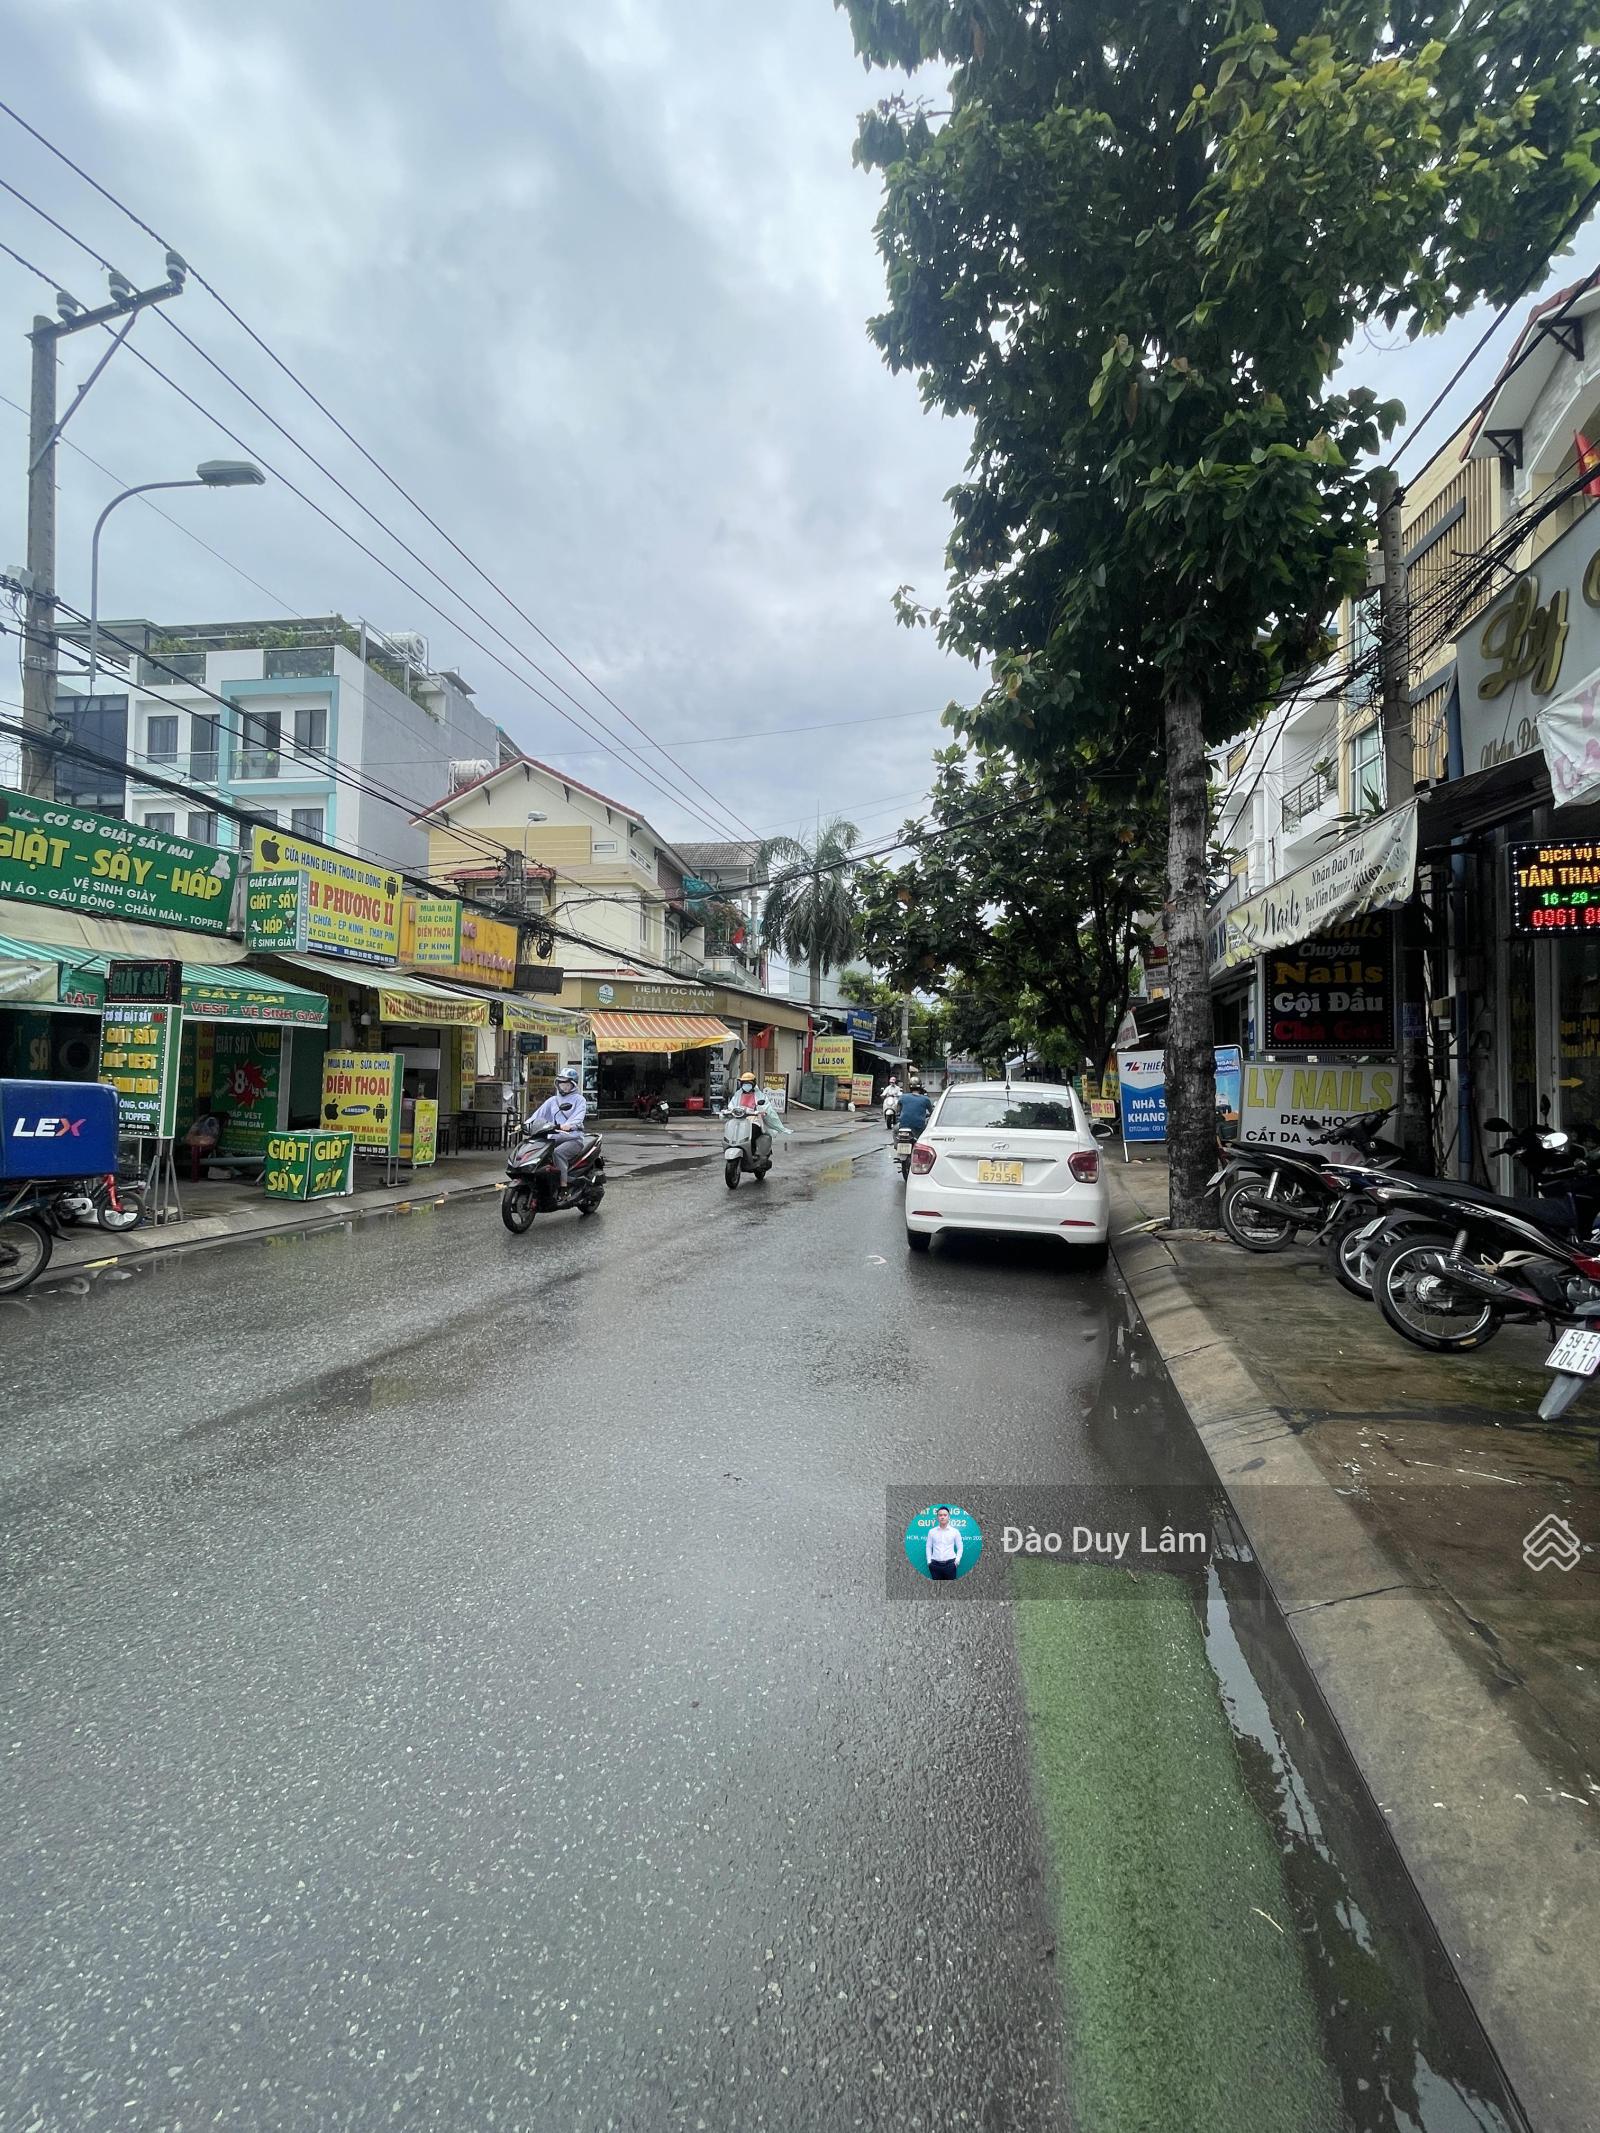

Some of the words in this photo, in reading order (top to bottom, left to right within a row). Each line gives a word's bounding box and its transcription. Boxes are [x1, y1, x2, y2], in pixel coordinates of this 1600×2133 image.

[43, 812, 71, 827] CƠ
[71, 815, 97, 834] SỞ
[99, 826, 136, 851] GIẶT
[136, 830, 167, 853] SẤY
[167, 844, 194, 860] MAI
[1539, 849, 1572, 863] DỊCH
[91, 846, 154, 885] SẤY
[170, 865, 222, 900] HẤP
[1518, 864, 1554, 887] TÂN
[73, 878, 91, 892] VỆ
[92, 882, 123, 896] SINH
[127, 887, 157, 902] GIÀY
[15, 881, 37, 896] ÁO
[48, 886, 77, 902] GẤU
[80, 892, 116, 911] BÔNG
[124, 903, 156, 918] CHĂN
[159, 908, 183, 923] MÀN
[189, 915, 223, 930] TOPPER
[250, 891, 273, 912] GIẶT
[277, 888, 298, 909] SẤY
[262, 913, 282, 934] HẤP
[1532, 908, 1577, 927] 0961
[258, 937, 275, 947] SINH
[277, 936, 296, 947] GIÀY
[1299, 943, 1360, 960] Chuyên
[1273, 961, 1384, 985] Nails
[633, 984, 661, 995] TIỆM
[689, 987, 715, 997] NAM
[191, 1001, 229, 1016] VEST
[691, 998, 714, 1010] AN
[1273, 992, 1321, 1018] Gội
[1328, 987, 1384, 1012] Đầu
[663, 1041, 678, 1051] AN
[1247, 1068, 1284, 1109] LY
[1291, 1070, 1394, 1113] NAILS
[1132, 1097, 1156, 1109] NHÀ
[1158, 1099, 1167, 1109] S
[1127, 1112, 1166, 1123] KHANG
[13, 1118, 87, 1137] LEX
[1246, 1126, 1277, 1143] CẮT
[1280, 1132, 1302, 1143] DA
[268, 1137, 309, 1166] GIẶT
[315, 1136, 350, 1164] GIẶT
[267, 1166, 304, 1194] SẤY
[983, 1173, 1017, 1183] 679.56
